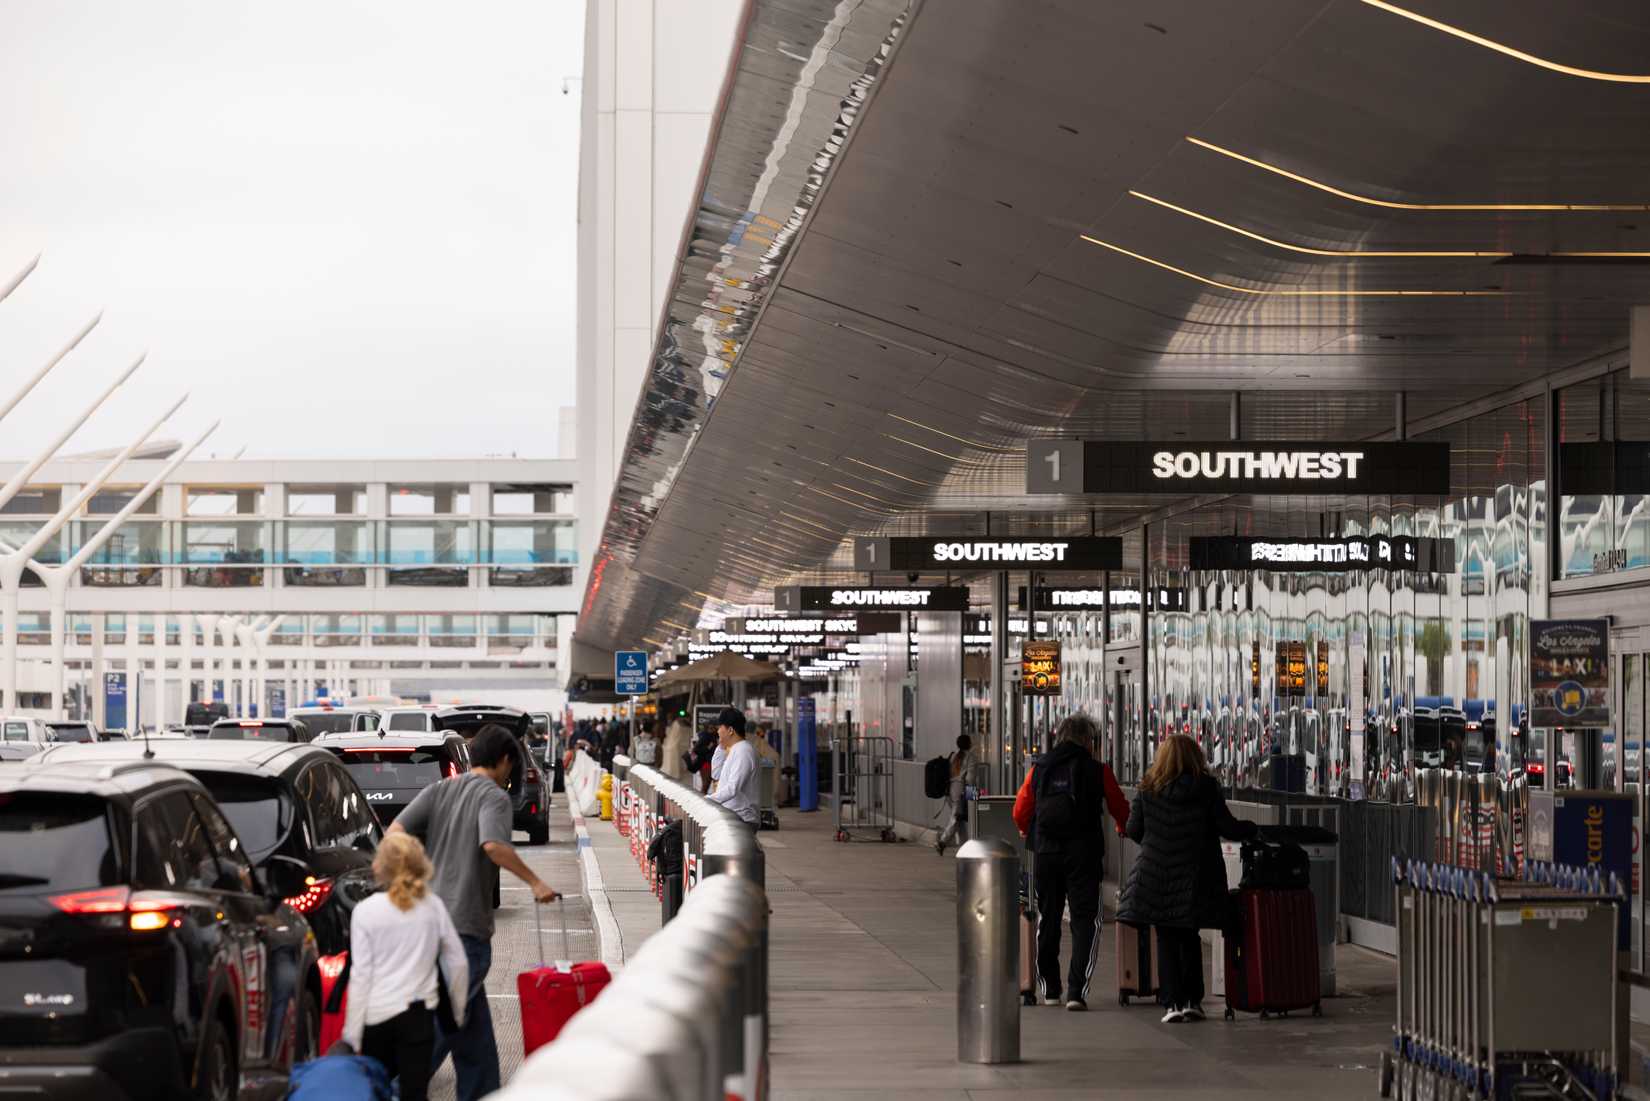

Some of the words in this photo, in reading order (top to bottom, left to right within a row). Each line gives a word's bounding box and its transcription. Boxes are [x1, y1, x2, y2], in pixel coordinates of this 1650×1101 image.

[1044, 449, 1060, 481] 1
[1152, 451, 1365, 479] SOUTHWEST
[865, 543, 876, 563] 1
[933, 542, 1069, 561] SOUTHWEST
[783, 593, 790, 605] 1
[830, 590, 931, 606] SOUTHWEST
[745, 619, 824, 632] SOUTHWEST
